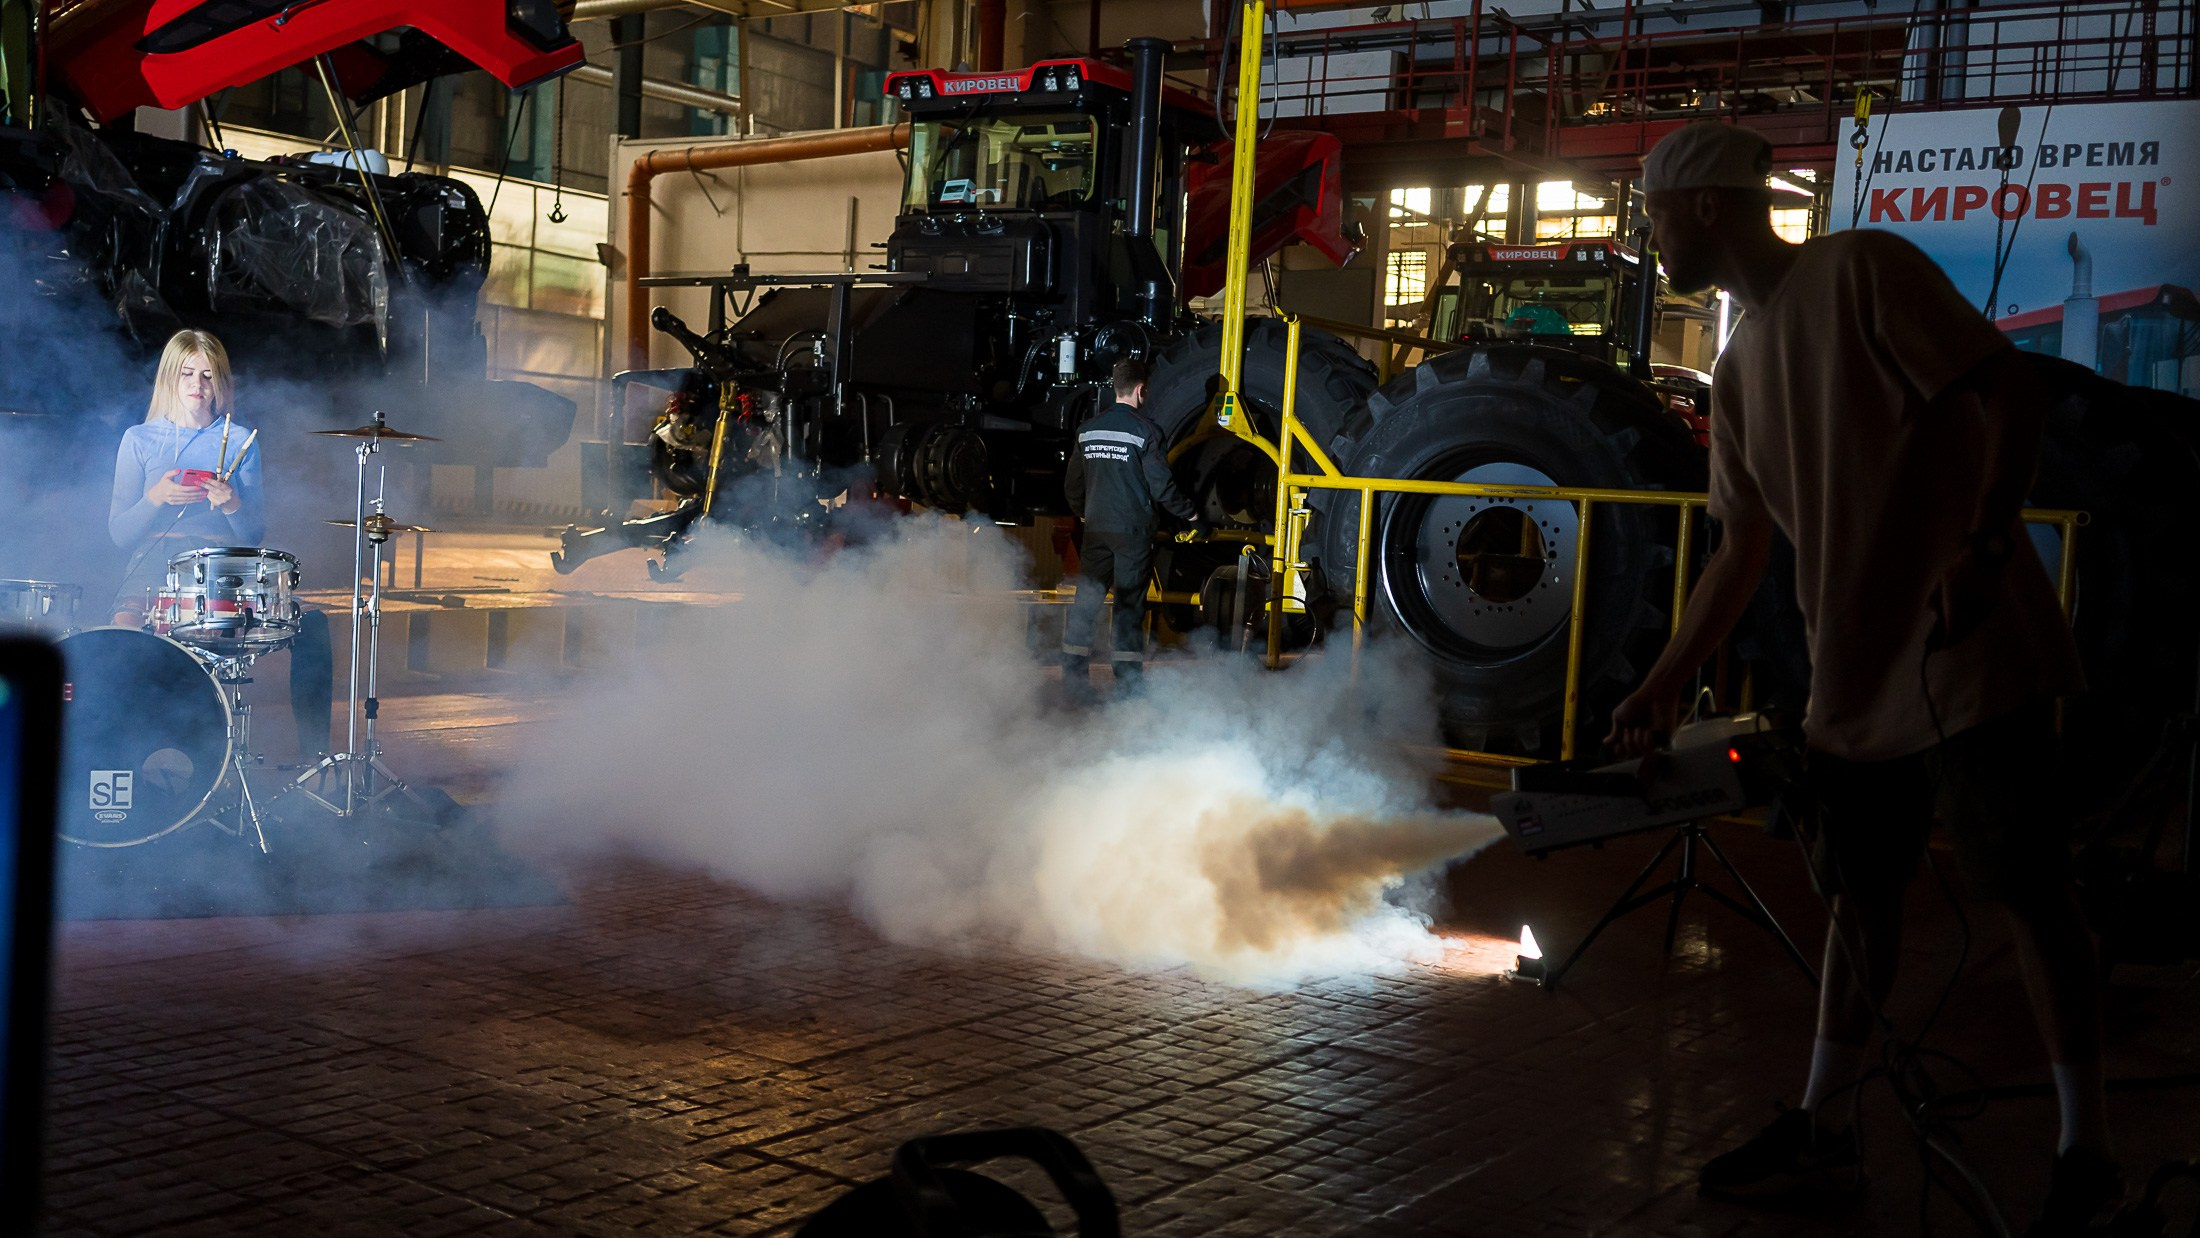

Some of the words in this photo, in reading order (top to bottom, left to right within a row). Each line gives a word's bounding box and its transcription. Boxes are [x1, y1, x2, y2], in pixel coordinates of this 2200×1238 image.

[944, 77, 1020, 93] КИРОВЕЦ
[1874, 145, 2024, 174] НАСТАЛО
[2039, 141, 2161, 168] ВРЕМЯ
[1869, 181, 2158, 226] КИРОВЕЦ
[1496, 250, 1558, 260] КИРОВЕЦ
